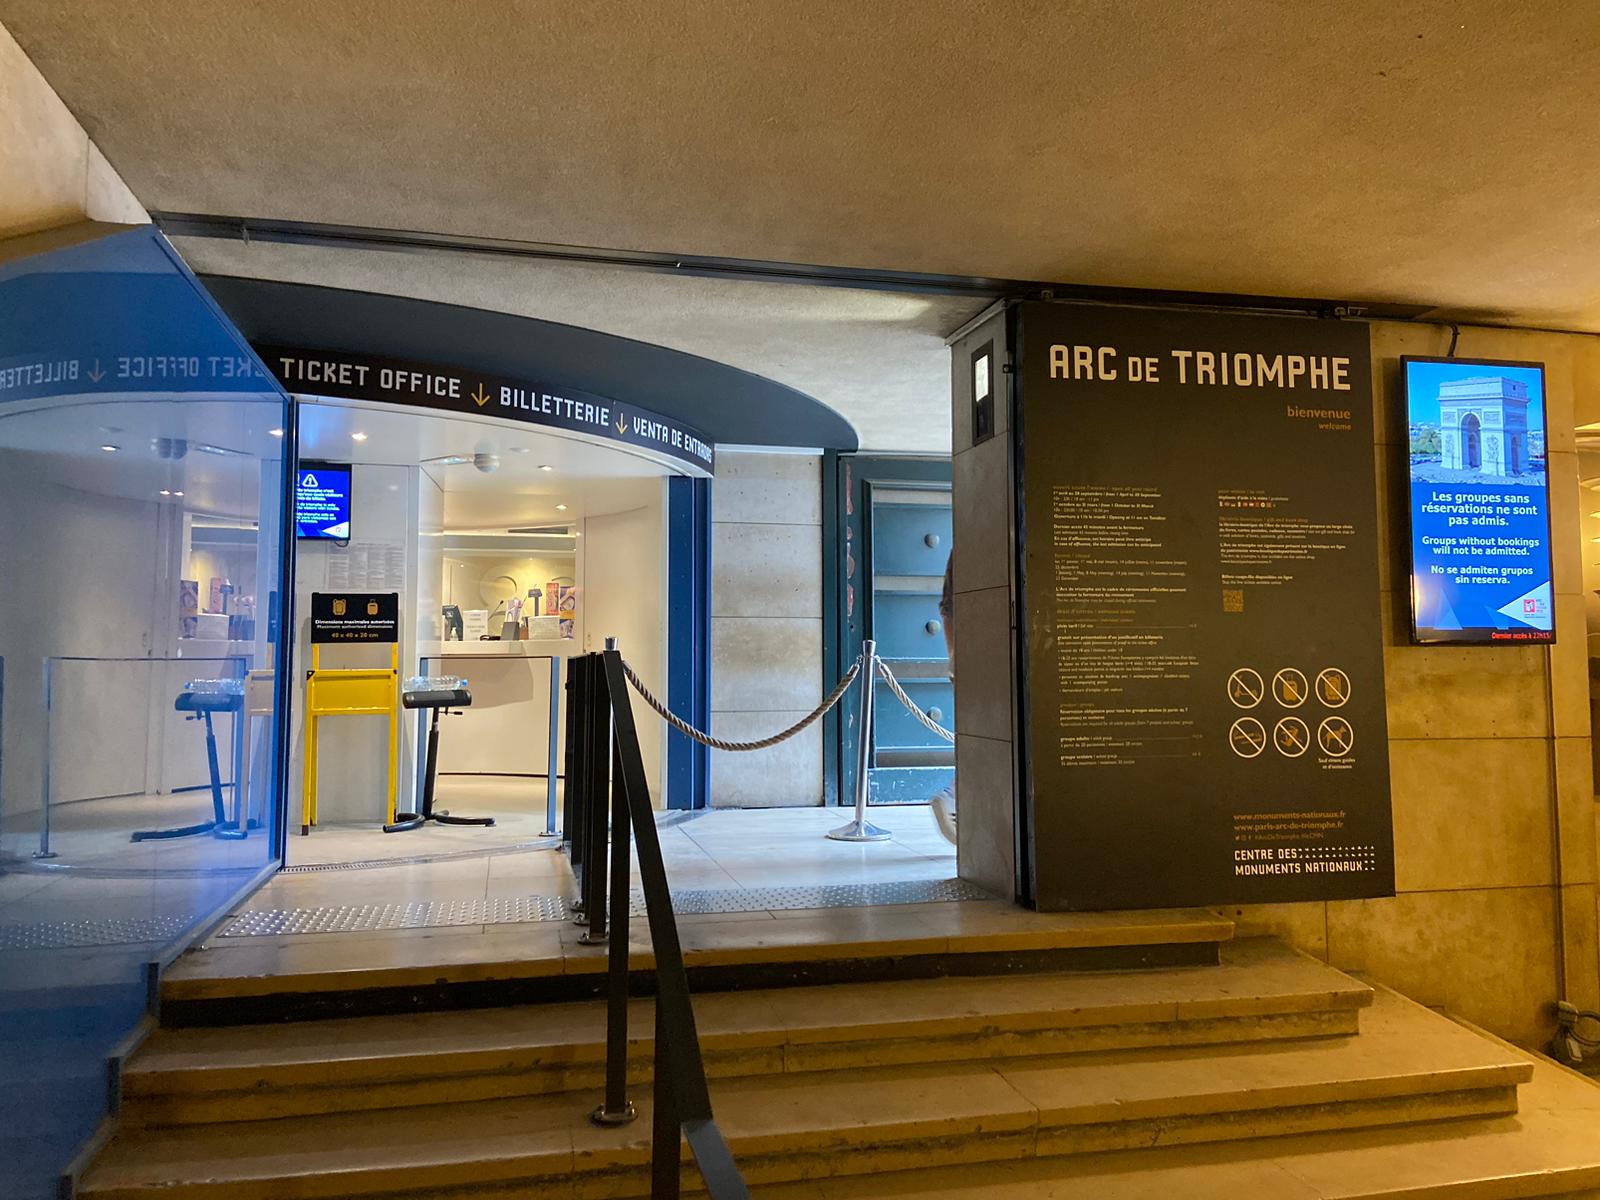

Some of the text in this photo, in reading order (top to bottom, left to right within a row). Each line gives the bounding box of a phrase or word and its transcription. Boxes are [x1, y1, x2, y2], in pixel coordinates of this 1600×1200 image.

[1050, 344, 1351, 391] ARC DE TRIOMPHE
[279, 357, 370, 386] TICKET
[380, 368, 461, 399] OFFICE
[500, 386, 610, 427] BILLETTERIE
[633, 416, 669, 443] VENTA
[671, 428, 683, 448] DE
[1287, 405, 1351, 420] bienvenue
[1318, 421, 1352, 431] welcome
[1432, 491, 1530, 505] Les groupes sans
[1421, 502, 1538, 515] réservations ne sont
[1448, 515, 1510, 527] pas admis.
[1422, 536, 1540, 548] Groups without bookings
[1433, 545, 1530, 556] will not be admitted.
[1431, 565, 1444, 574] No
[1460, 566, 1499, 574] admiten
[1501, 567, 1533, 576] grupos
[1455, 575, 1511, 584] sin reserva.
[1234, 848, 1297, 861] CENTRE DES
[1235, 860, 1363, 876] MONUMENTS NATIONAUX
